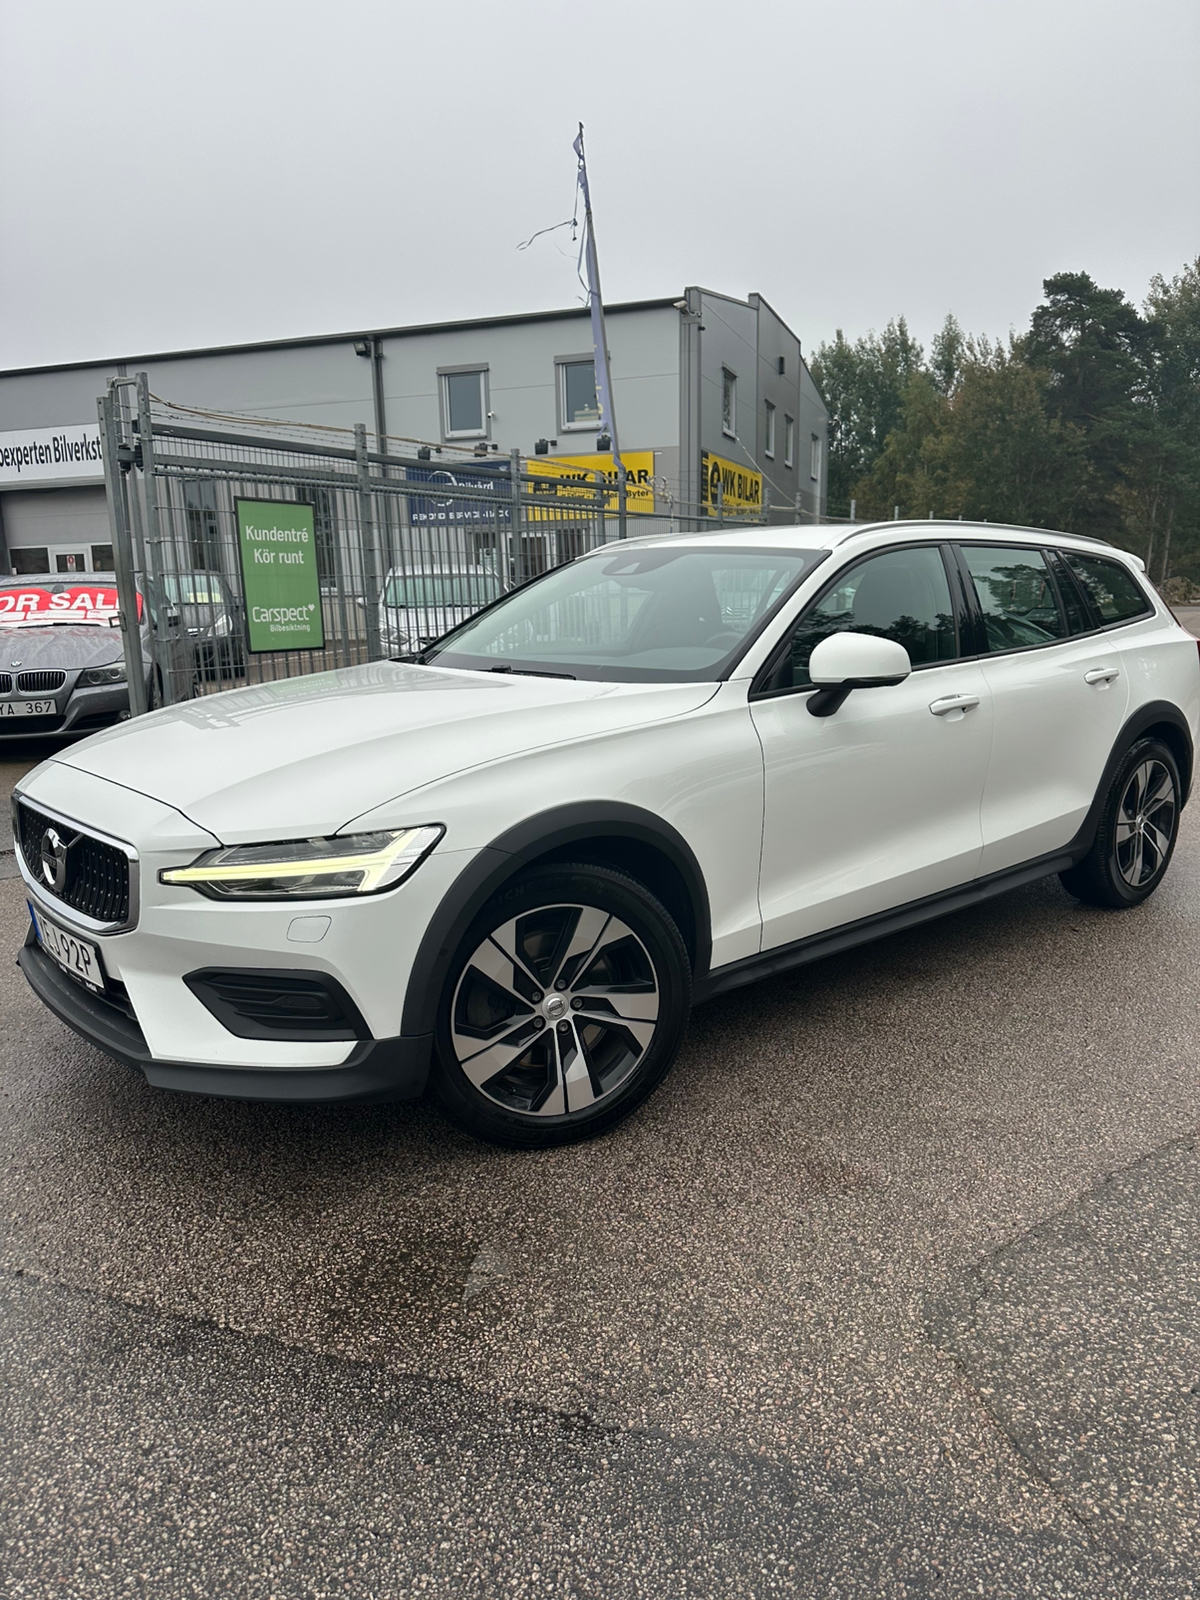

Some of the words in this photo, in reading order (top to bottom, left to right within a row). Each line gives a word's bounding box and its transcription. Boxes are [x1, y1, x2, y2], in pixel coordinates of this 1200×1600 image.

[738, 473, 759, 504] BILAR
[245, 525, 309, 543] Kundentré
[254, 548, 275, 564] Kör
[278, 550, 304, 564] runt
[48, 592, 119, 610] SAL
[252, 605, 310, 624] Carspect
[269, 624, 311, 633] Bilbesiktning
[25, 701, 52, 714] 367
